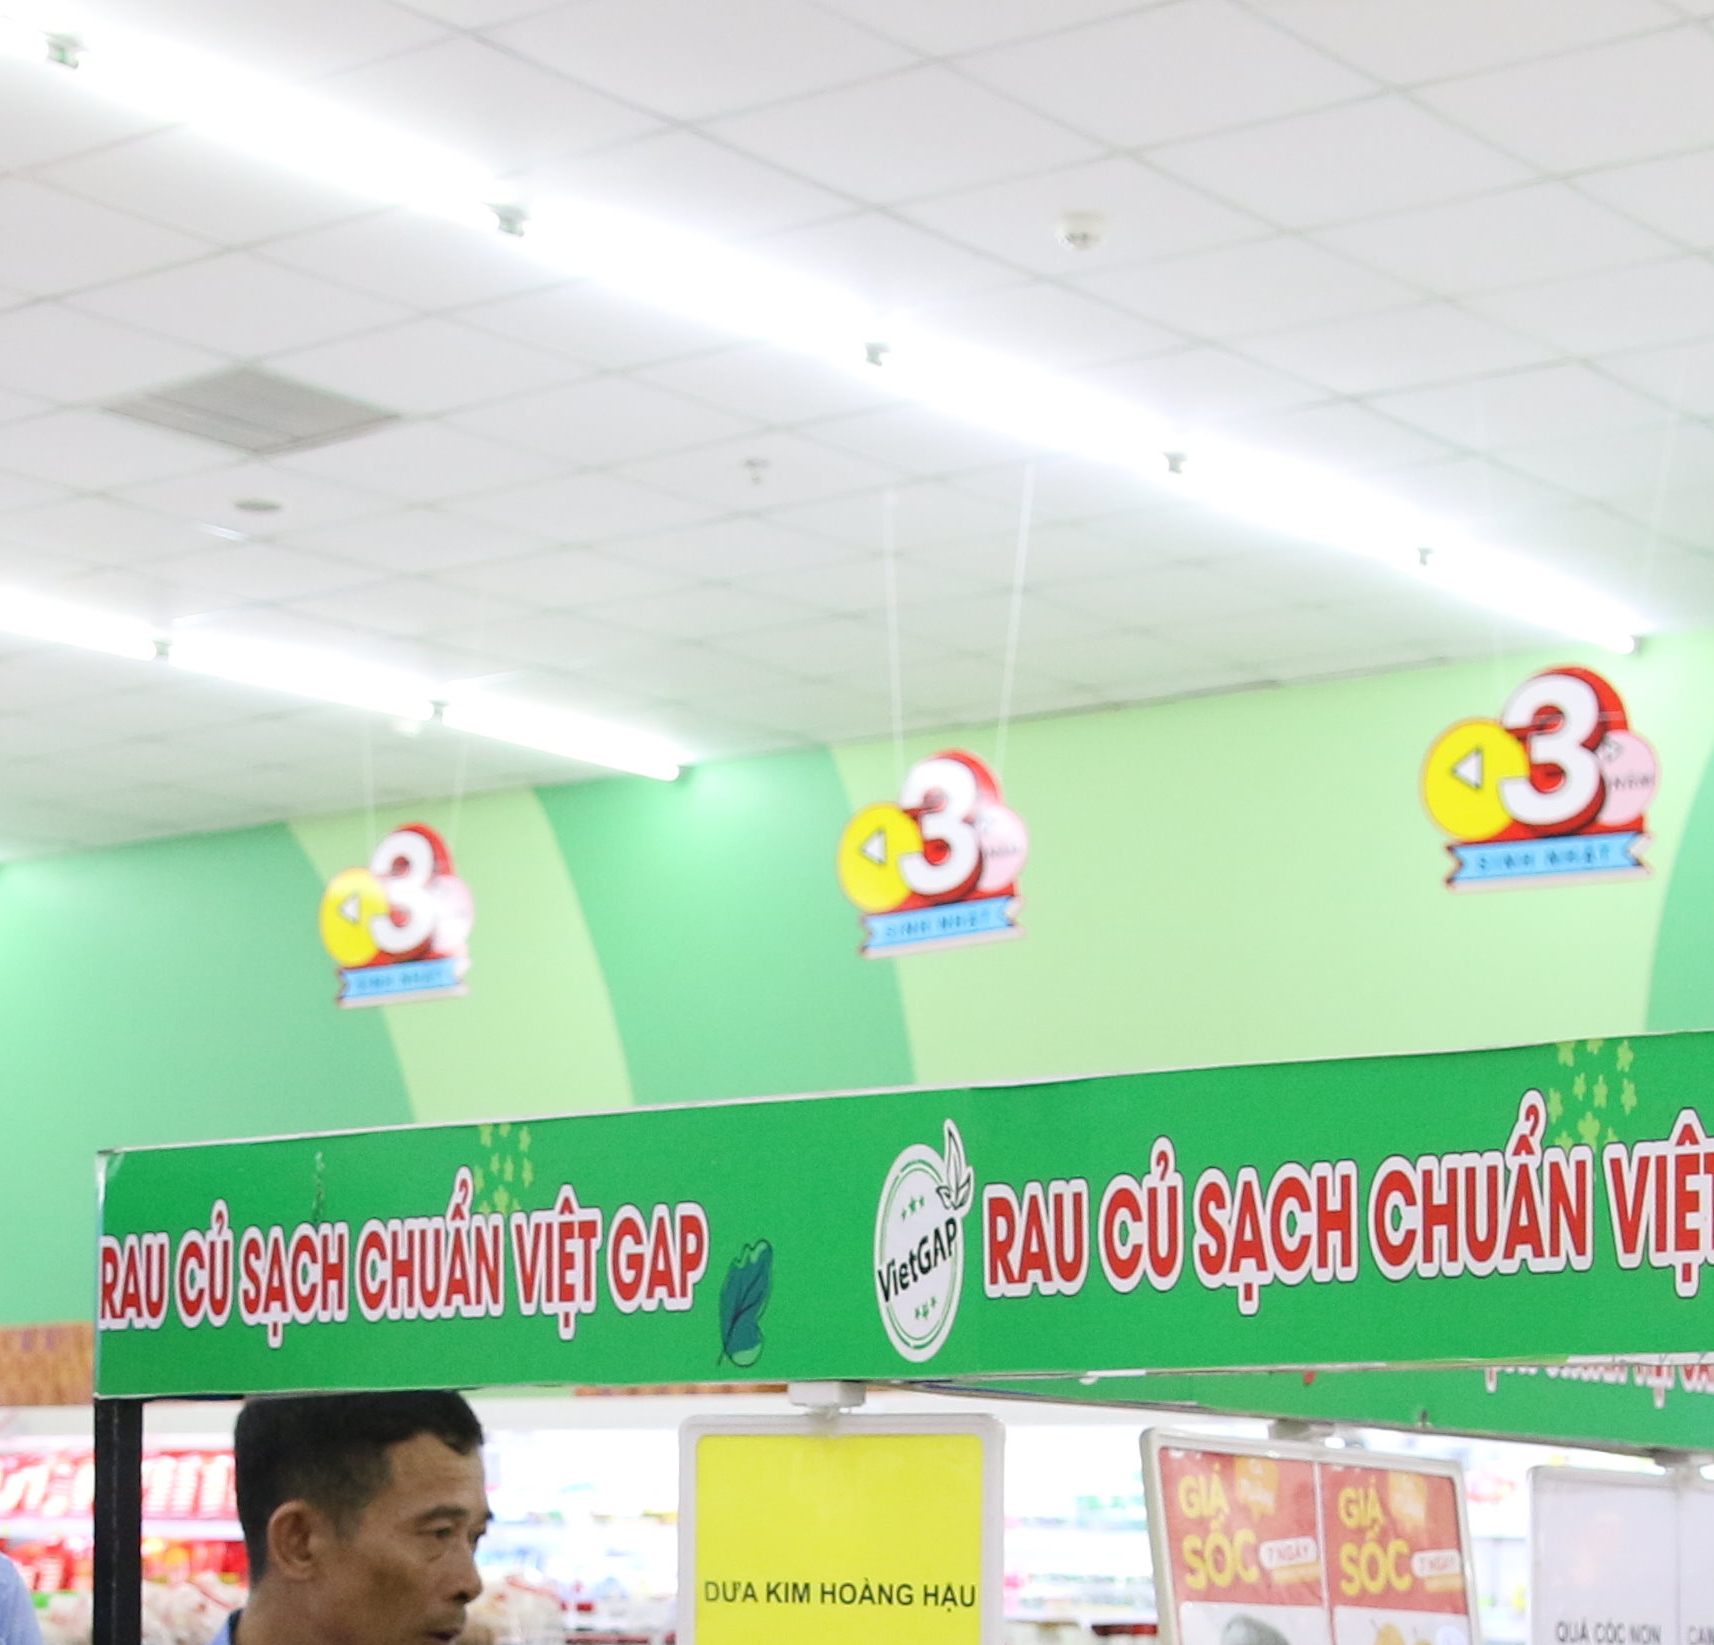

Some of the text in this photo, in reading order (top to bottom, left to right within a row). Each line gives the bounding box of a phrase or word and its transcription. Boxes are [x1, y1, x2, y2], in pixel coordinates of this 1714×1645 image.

[1498, 672, 1601, 826] 3
[370, 829, 436, 954] 3
[898, 756, 982, 896] 3
[100, 1169, 706, 1346] RAU CỦ SẠCH CHUẨN VIỆT GAP
[878, 1217, 957, 1303] VietGAP
[984, 1181, 1087, 1296] RAU
[1101, 1140, 1179, 1290] CỦ
[1196, 1164, 1355, 1313] SẠCH
[1371, 1092, 1592, 1280] CHUẨN
[704, 1579, 759, 1604] DƯA
[765, 1580, 811, 1605] KIM
[819, 1576, 915, 1608] HOÀNG
